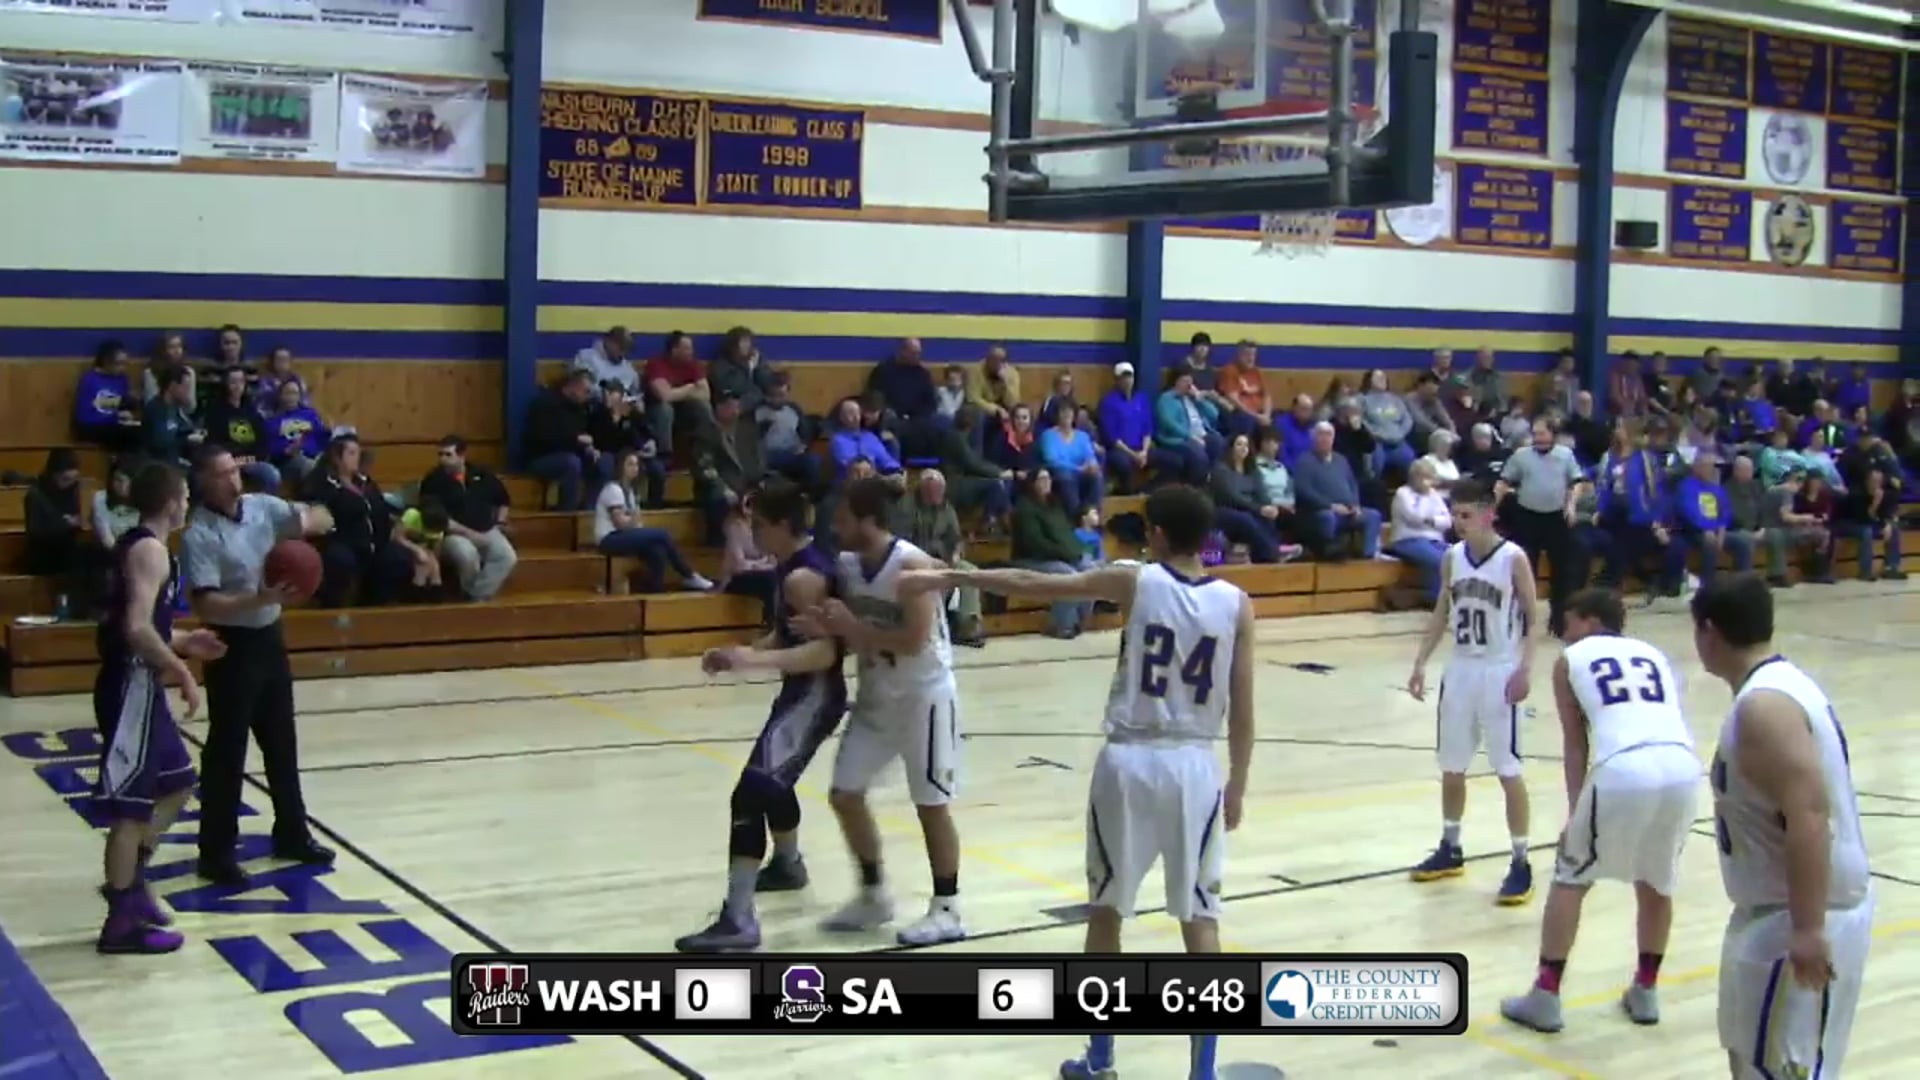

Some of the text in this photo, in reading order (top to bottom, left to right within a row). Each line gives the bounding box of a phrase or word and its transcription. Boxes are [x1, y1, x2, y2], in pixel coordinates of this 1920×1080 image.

[814, 0, 888, 22] SCHOOL
[624, 117, 680, 137] CLASS
[806, 119, 845, 139] CLASS
[762, 146, 809, 167] 1998
[547, 160, 684, 188] STATE OF MAINE
[716, 173, 852, 198] STATE RUNNER-UP
[563, 179, 666, 201] RUNNER-UP
[1456, 608, 1488, 645] 20
[1141, 624, 1218, 704] 24
[1589, 656, 1664, 706] 23
